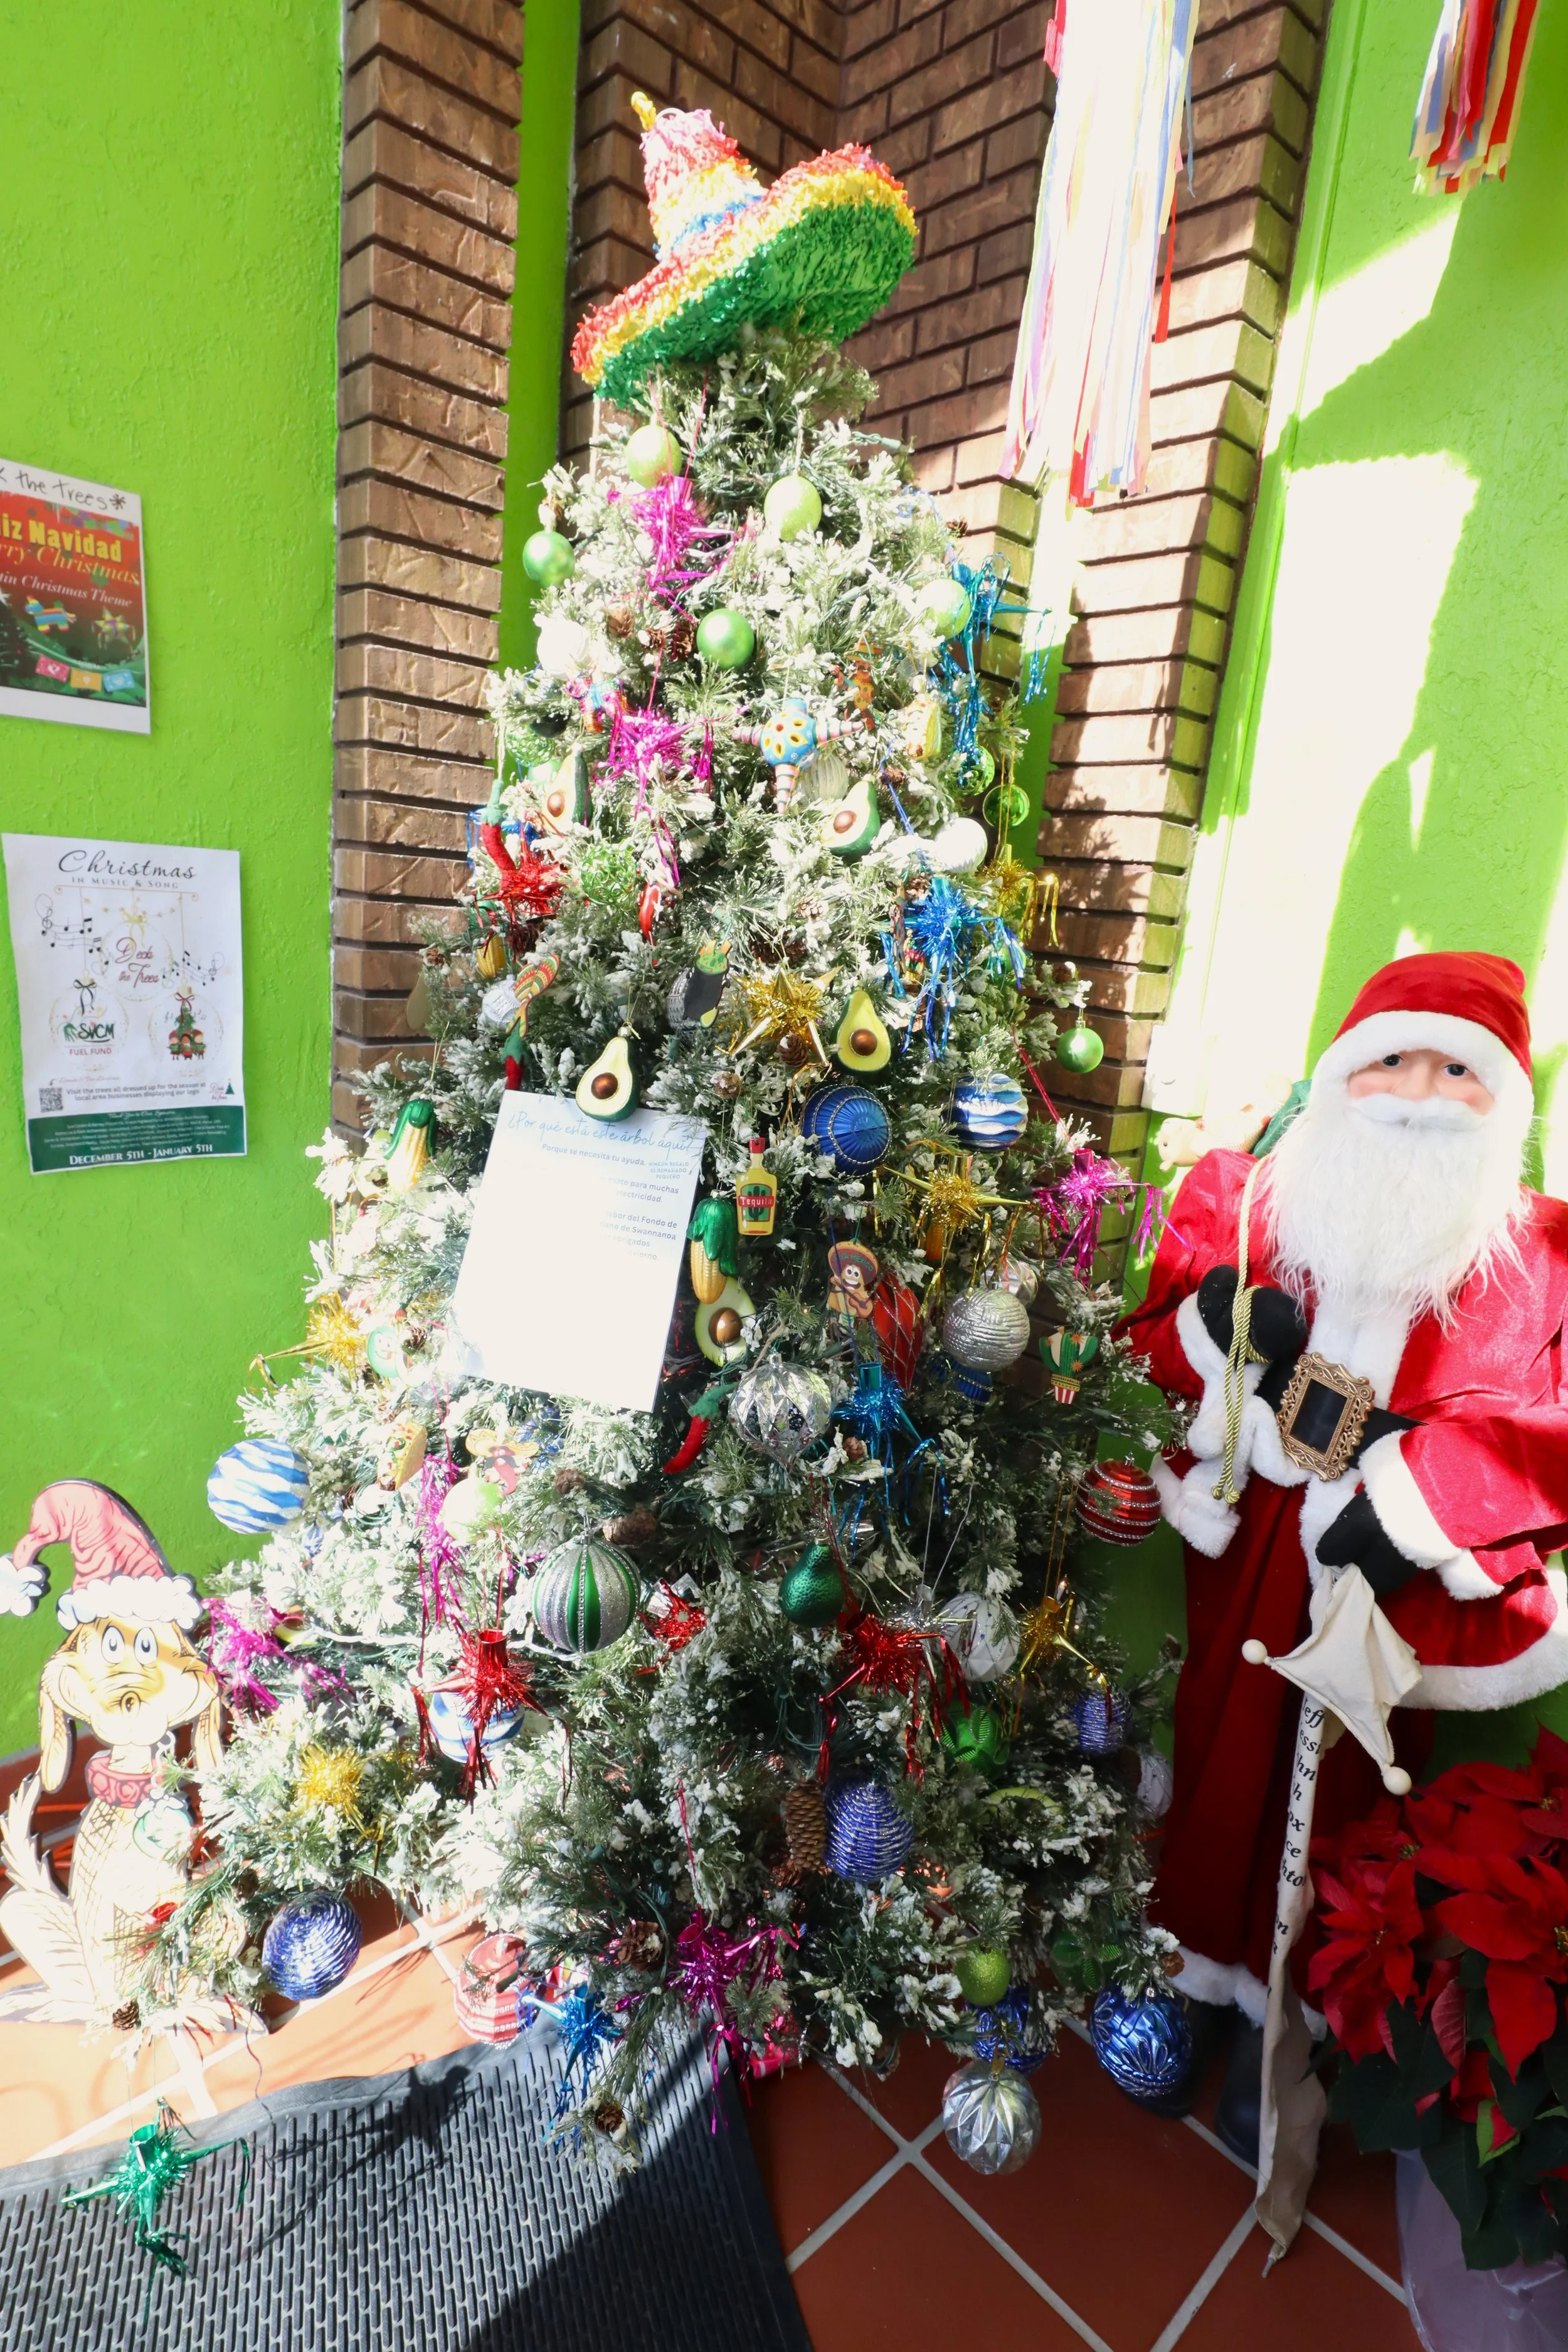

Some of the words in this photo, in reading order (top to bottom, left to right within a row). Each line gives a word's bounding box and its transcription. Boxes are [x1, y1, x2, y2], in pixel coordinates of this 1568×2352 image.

[16, 470, 48, 494] the
[0, 512, 23, 541] iz
[28, 519, 122, 563] Navidad
[36, 546, 140, 586] Christmas
[21, 575, 88, 598] Christmas
[91, 587, 133, 608] Theme
[58, 849, 198, 880] Christmas
[91, 877, 128, 887] MUSIC
[148, 881, 179, 889] SONG
[78, 1022, 115, 1040] SVCM
[593, 1121, 618, 1140] este
[620, 1128, 655, 1147] árbol
[69, 1153, 123, 1165] DECEMBER
[126, 1150, 144, 1159] 5TH
[153, 1145, 193, 1158] JANUARY
[196, 1143, 213, 1153] 5TH
[541, 1143, 568, 1155] Porque
[568, 1148, 578, 1156] se
[579, 1149, 611, 1162] necesita
[612, 1153, 620, 1162] tu
[621, 1155, 646, 1167] ayuda.
[630, 1181, 648, 1189] para
[649, 1183, 679, 1194] muchas
[739, 1195, 773, 1208] Tequila
[600, 1221, 620, 1231] tiano
[620, 1223, 631, 1232] de
[632, 1226, 677, 1241] Swannanoa
[627, 1212, 640, 1222] del
[641, 1216, 665, 1227] Fondo
[667, 1220, 677, 1229] de
